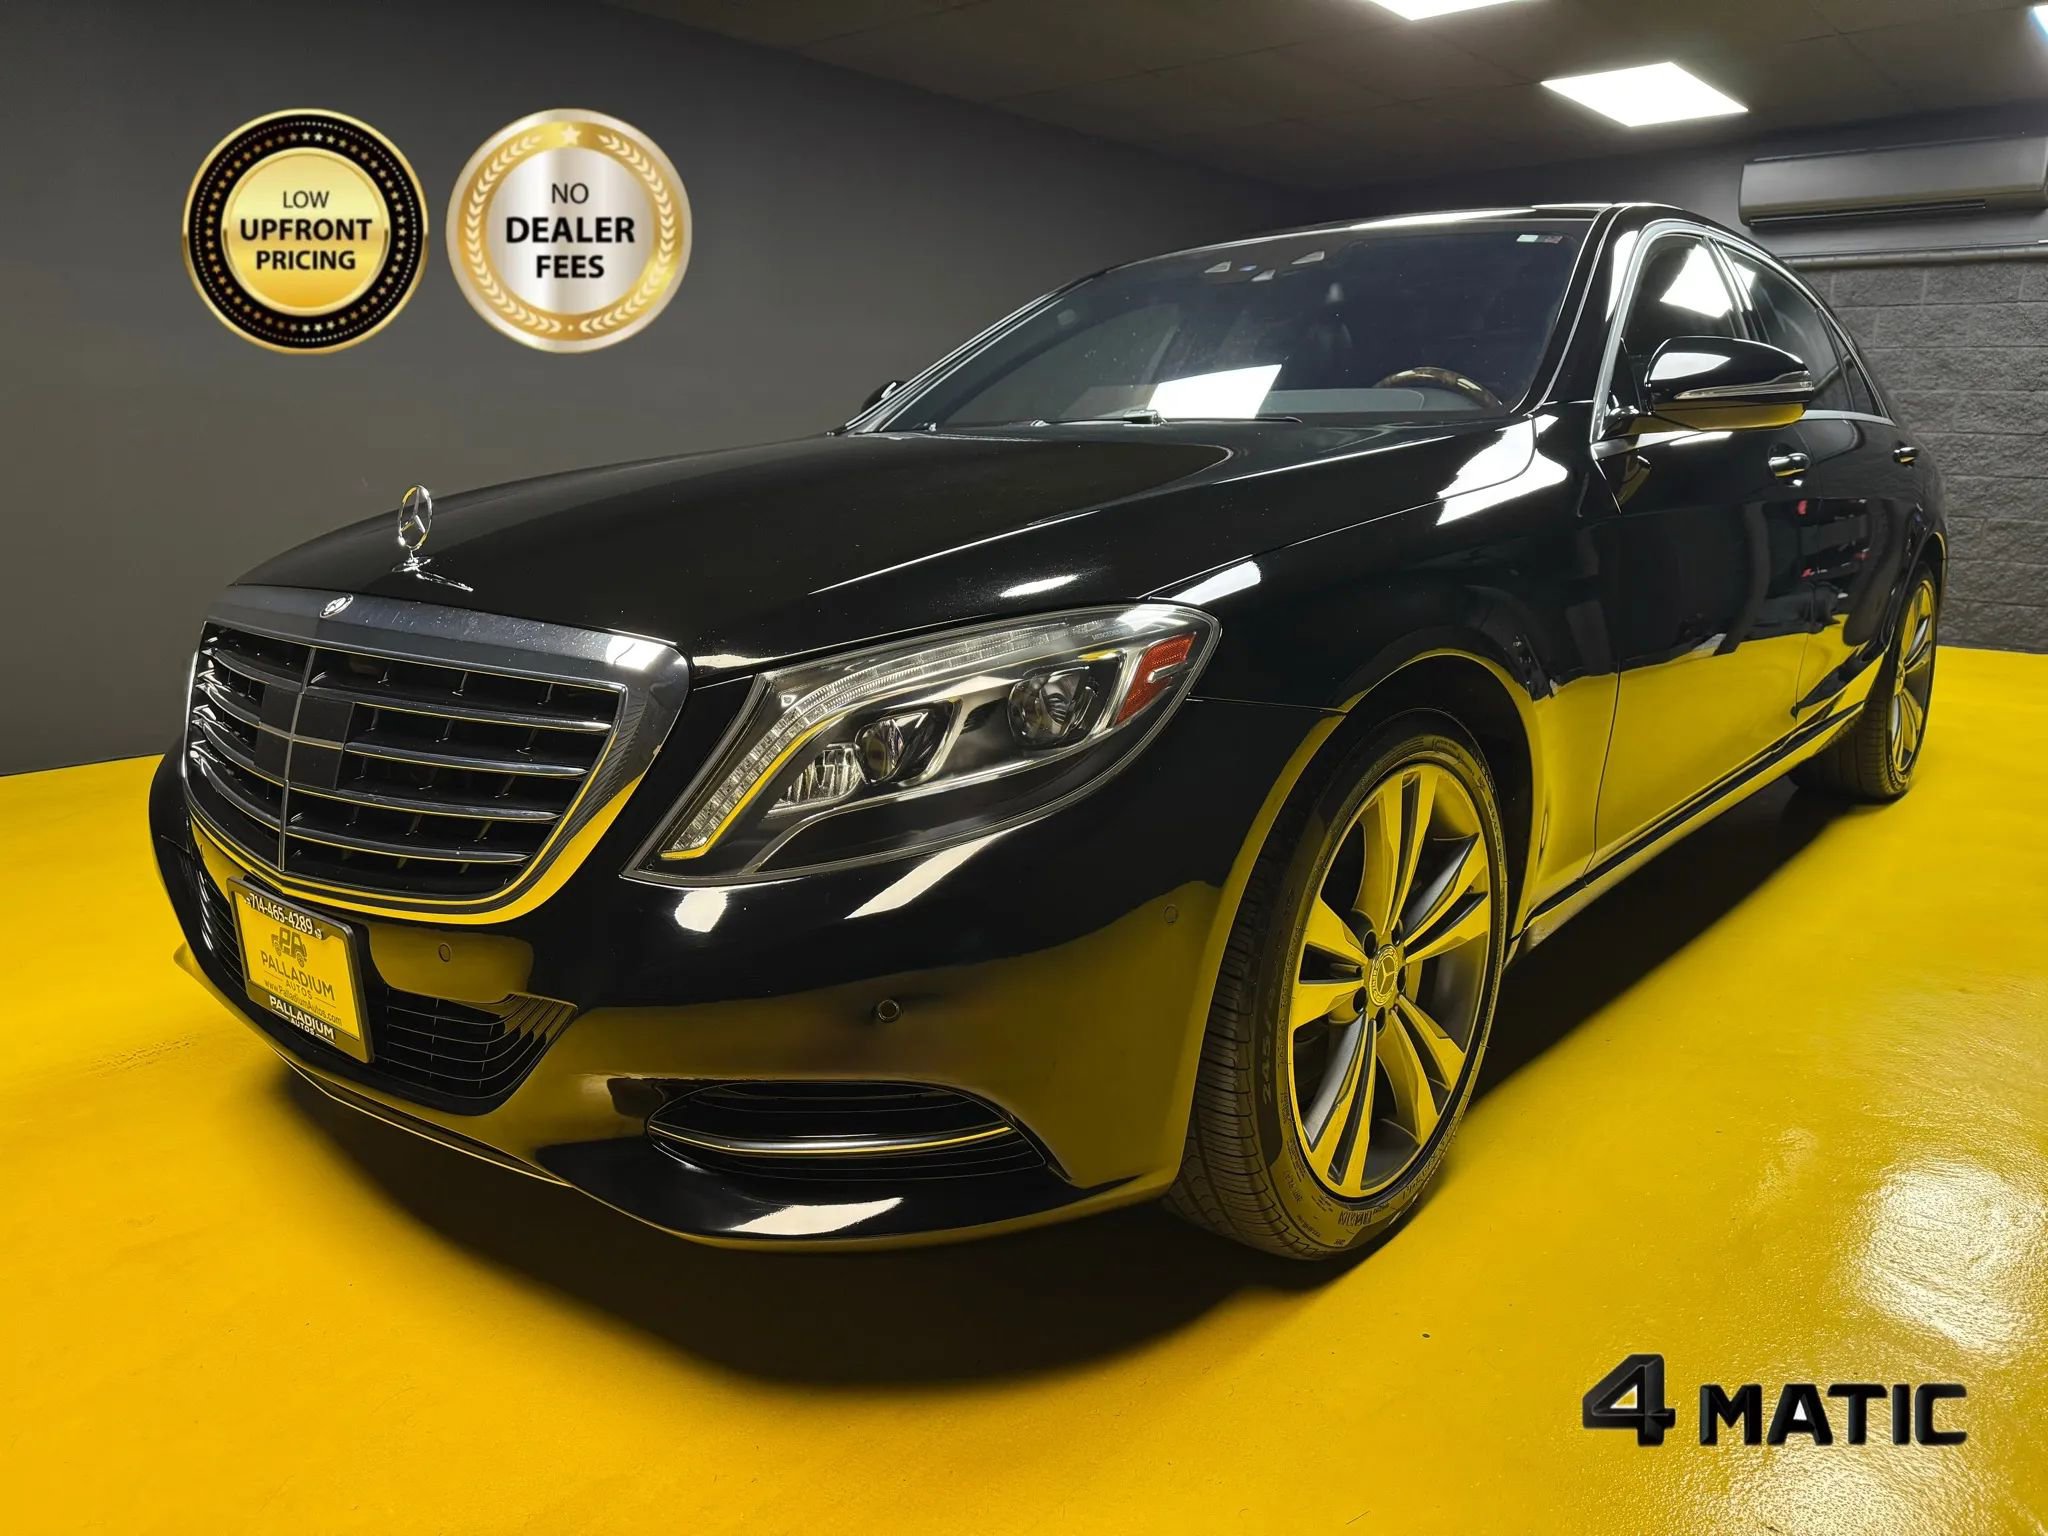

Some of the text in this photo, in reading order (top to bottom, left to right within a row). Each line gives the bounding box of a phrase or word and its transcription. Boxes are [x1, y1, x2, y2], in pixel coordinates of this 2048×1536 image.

[249, 892, 313, 935] 714-465-4289
[261, 950, 335, 1001] PALLADIUM
[285, 979, 312, 1000] AUTOS
[269, 994, 335, 1040] PALLADIUM
[291, 1018, 315, 1036] AUTOS
